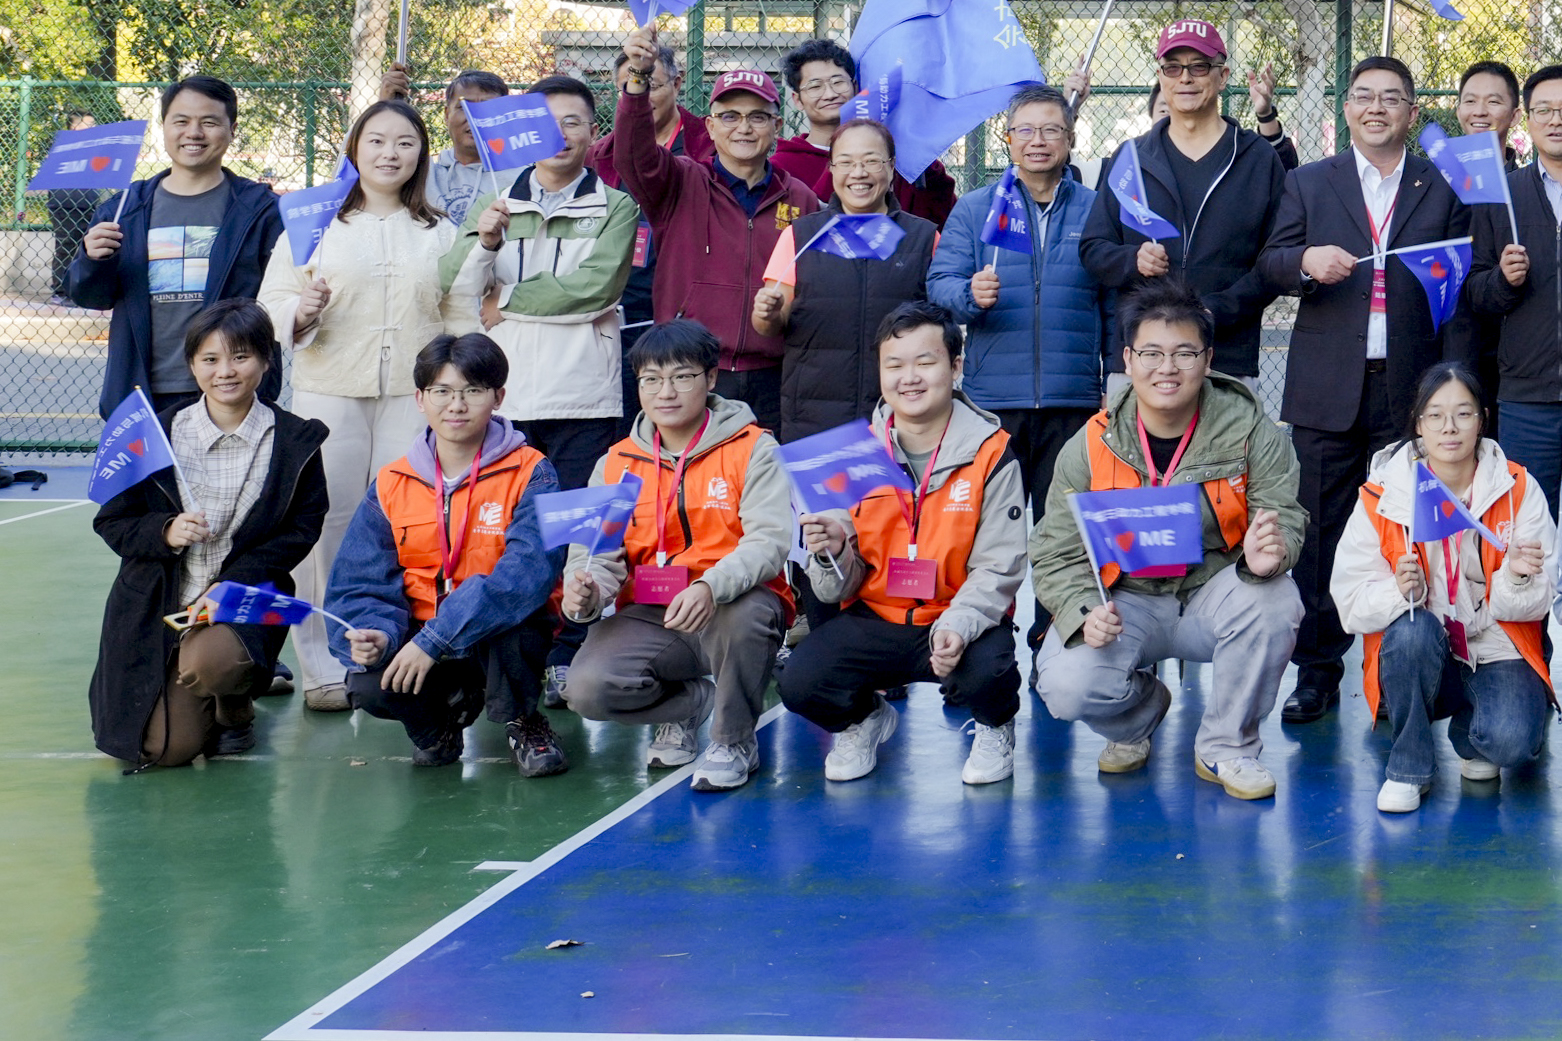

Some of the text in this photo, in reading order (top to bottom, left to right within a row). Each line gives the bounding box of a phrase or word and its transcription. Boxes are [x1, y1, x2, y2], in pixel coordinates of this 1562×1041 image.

[1168, 21, 1207, 40] SJTU
[723, 71, 764, 89] SJTU
[508, 130, 542, 151] ME
[1138, 529, 1177, 547] ME
